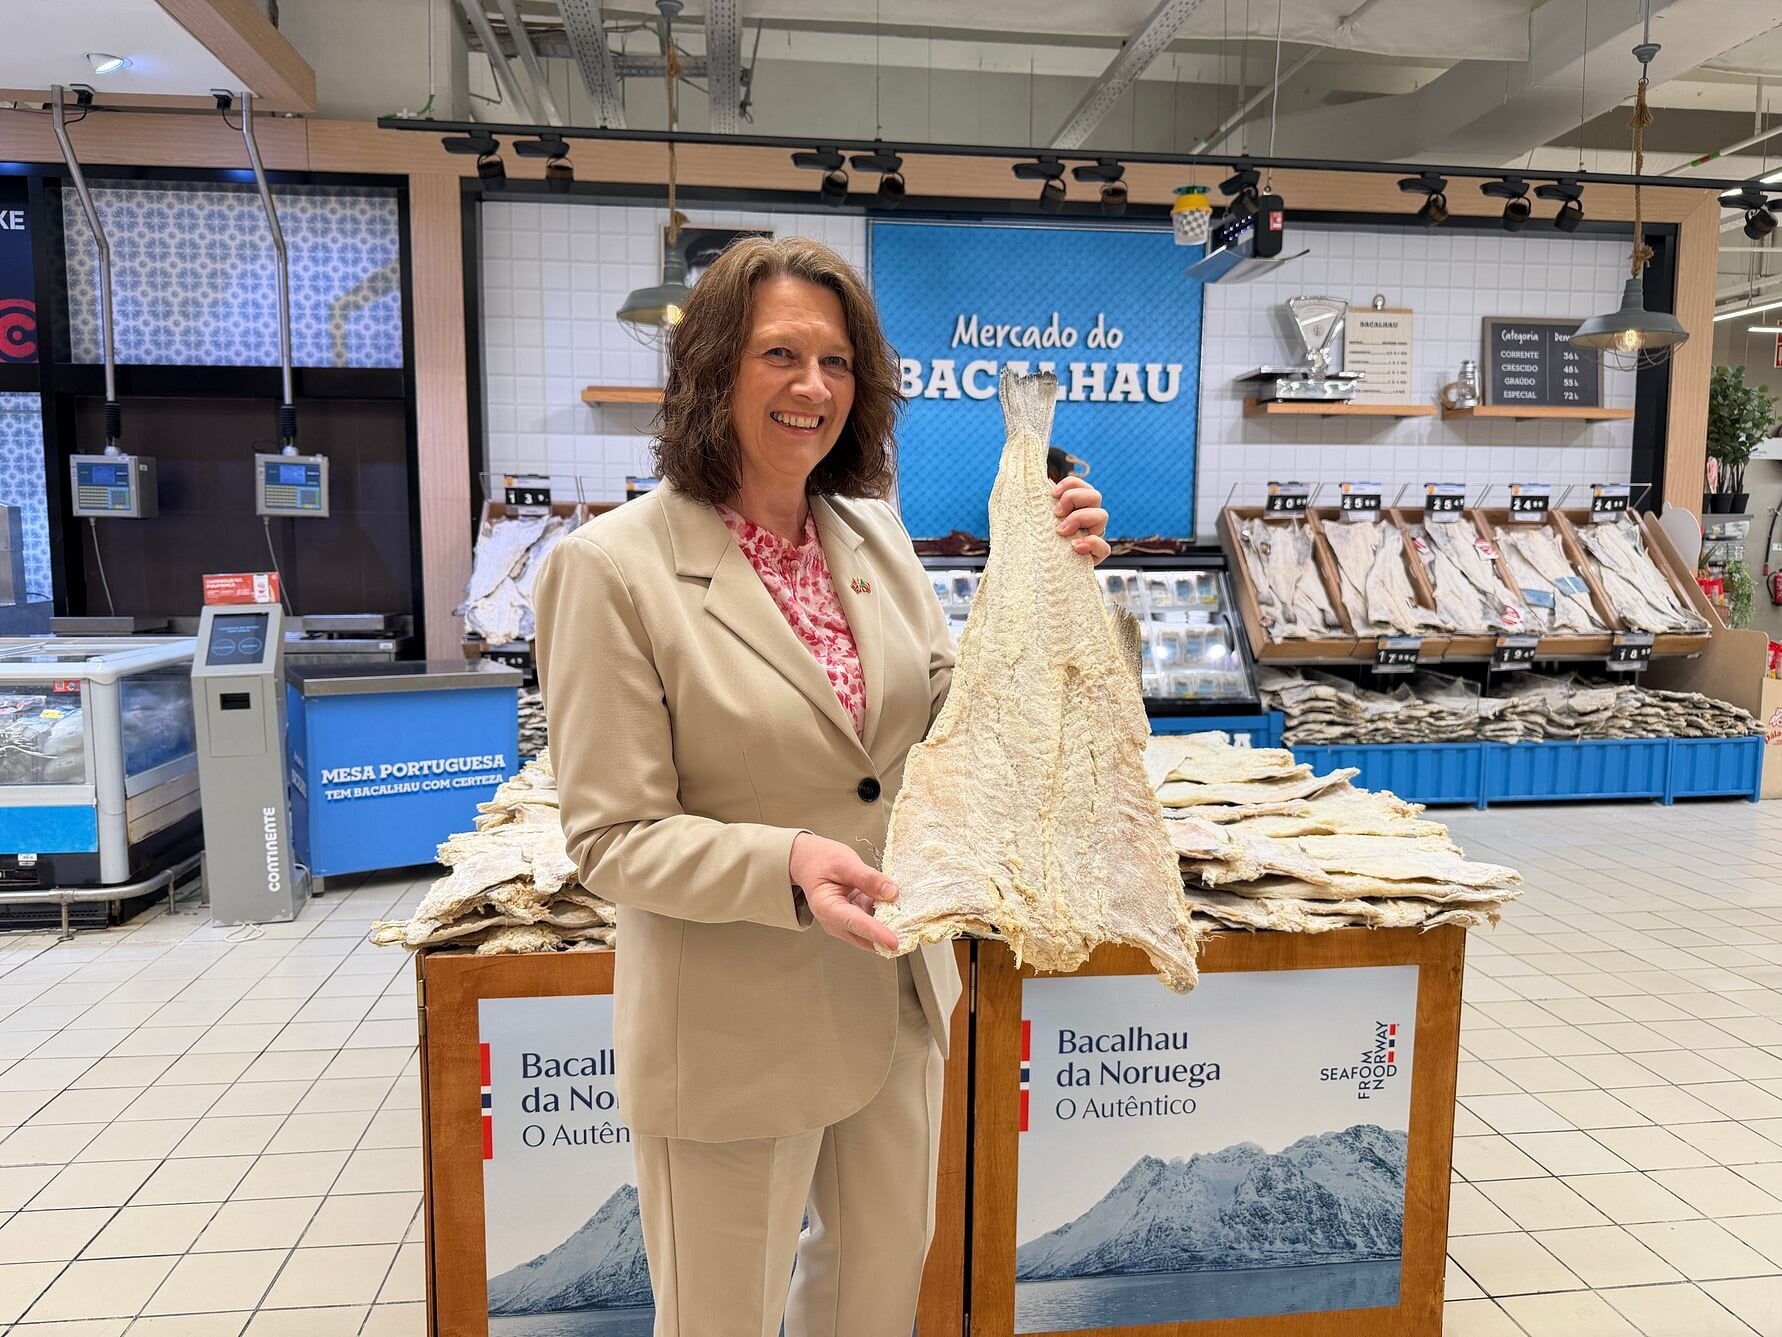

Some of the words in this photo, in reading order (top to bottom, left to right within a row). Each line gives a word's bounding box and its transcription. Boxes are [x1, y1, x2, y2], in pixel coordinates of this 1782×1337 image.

[951, 311, 1078, 350] Mercado
[1087, 313, 1124, 350] do
[1360, 321, 1398, 329] BACALHAU
[1501, 328, 1539, 344] Categoria
[1500, 350, 1539, 360] CORRENTE
[900, 358, 1183, 402] BACHAU
[1501, 364, 1538, 373] CRESCIDO
[1504, 376, 1536, 386] GRAÚDO
[1503, 390, 1537, 399] ESPECIAL
[321, 766, 376, 784] MESA
[379, 754, 506, 779] PORTUGUESA
[325, 789, 351, 800] TEM
[354, 781, 420, 797] BACALHAU
[422, 778, 450, 791] COM
[452, 774, 504, 789] CERTEZA
[263, 806, 281, 892] CONTINENTE
[1058, 1026, 1188, 1054] Bacalhau
[1056, 1062, 1091, 1087] da
[1100, 1060, 1221, 1088] Noruega
[1320, 1065, 1397, 1081] SEAFOOD
[1358, 1050, 1373, 1099] FROM
[521, 1086, 560, 1113] da
[570, 1084, 619, 1111] No
[1056, 1098, 1076, 1120] O
[1082, 1095, 1196, 1119] Autêntico
[522, 1124, 545, 1148] O
[552, 1121, 631, 1146] Autên
